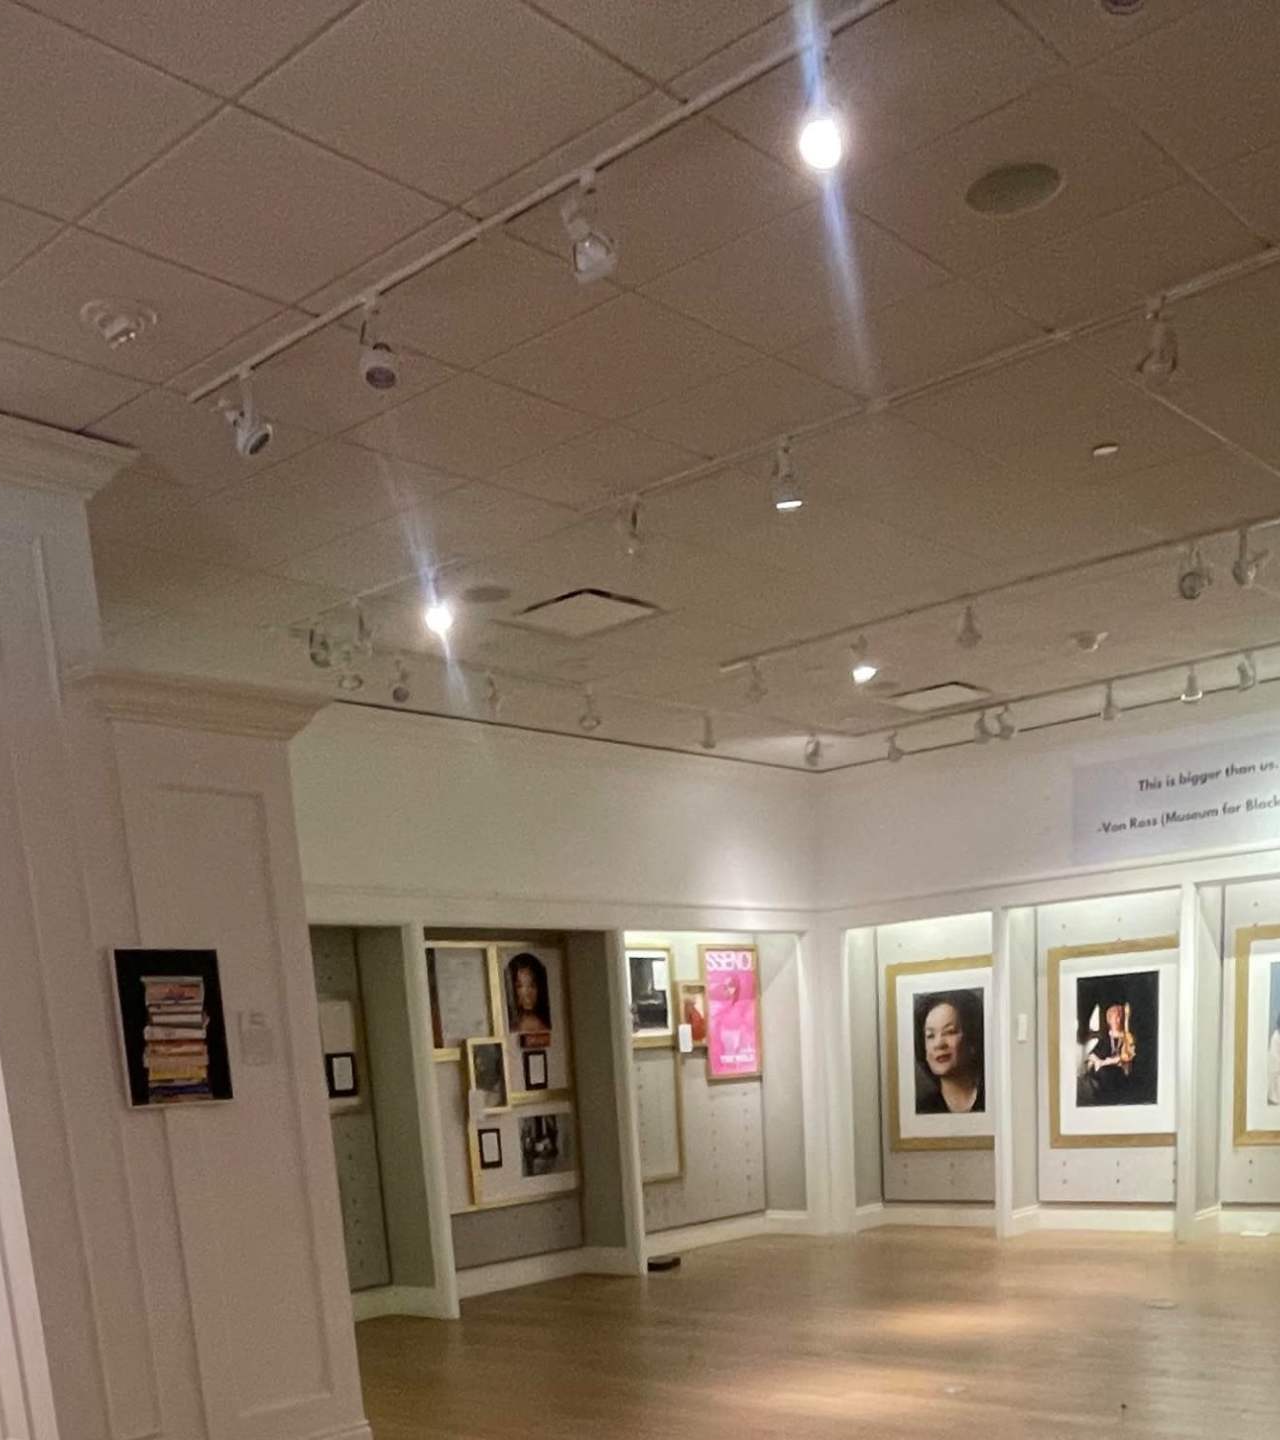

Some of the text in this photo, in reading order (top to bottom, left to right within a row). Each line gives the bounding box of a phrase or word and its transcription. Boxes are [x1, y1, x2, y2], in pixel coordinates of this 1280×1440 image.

[1138, 761, 1279, 791] This is bigger than us.
[1161, 808, 1219, 827] (Museum
[1222, 802, 1240, 814] for
[1246, 794, 1280, 812] Black
